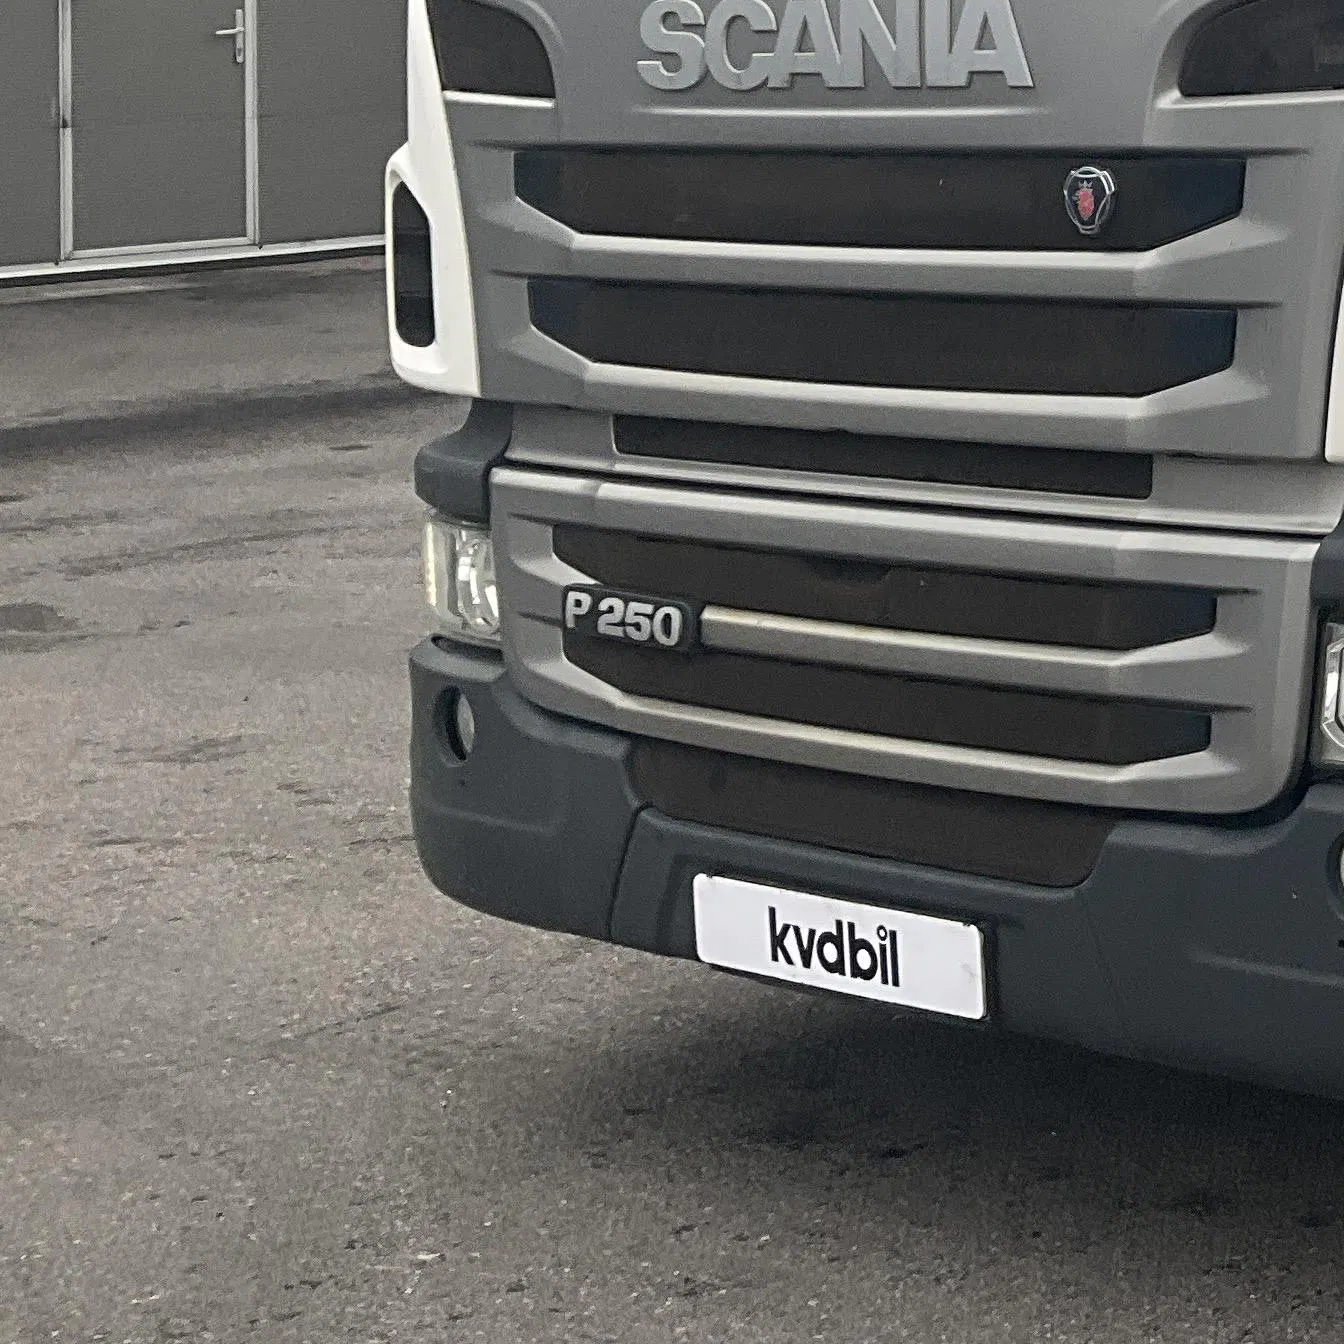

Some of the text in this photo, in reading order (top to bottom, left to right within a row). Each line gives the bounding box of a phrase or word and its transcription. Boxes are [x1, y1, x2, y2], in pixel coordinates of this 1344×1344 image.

[565, 590, 683, 647] P 250
[768, 905, 901, 988] kvdbil
